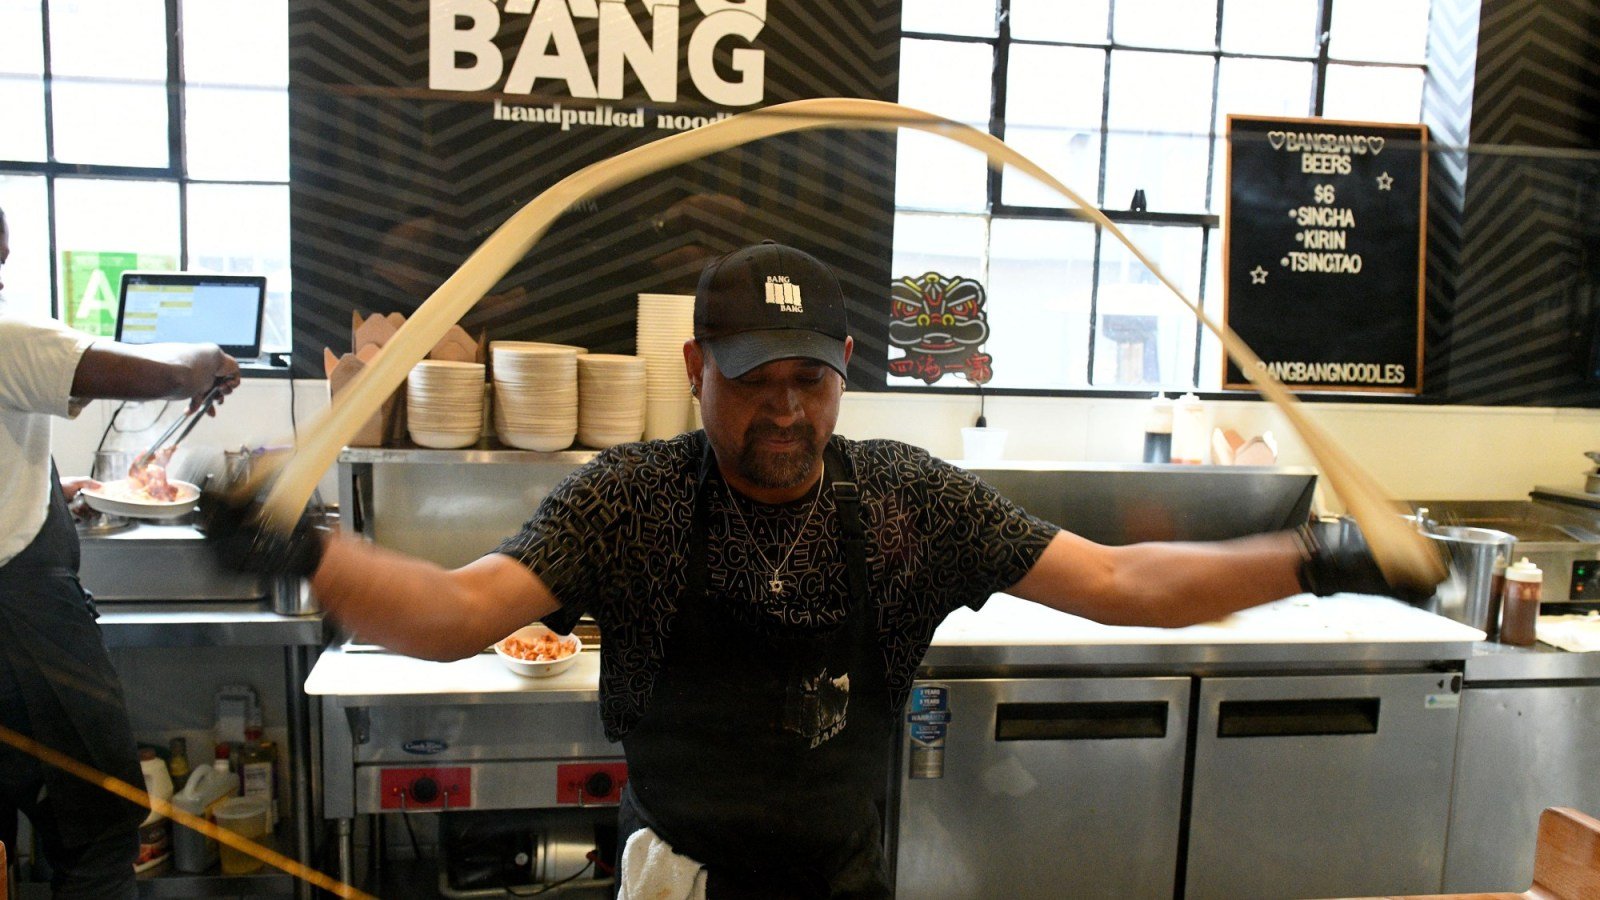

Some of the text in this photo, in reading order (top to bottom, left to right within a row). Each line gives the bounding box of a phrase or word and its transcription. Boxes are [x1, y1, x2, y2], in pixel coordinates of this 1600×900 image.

[428, 0, 766, 106] BANG
[493, 100, 645, 131] handpulled
[1286, 132, 1369, 155] BANGBANG
[1302, 153, 1351, 175] BEERS
[1314, 184, 1335, 204] $6
[1296, 208, 1355, 228] SINGHA
[1304, 230, 1346, 249] KIRIN
[766, 275, 790, 284] BANG
[75, 268, 117, 319] A
[780, 304, 804, 313] BANG
